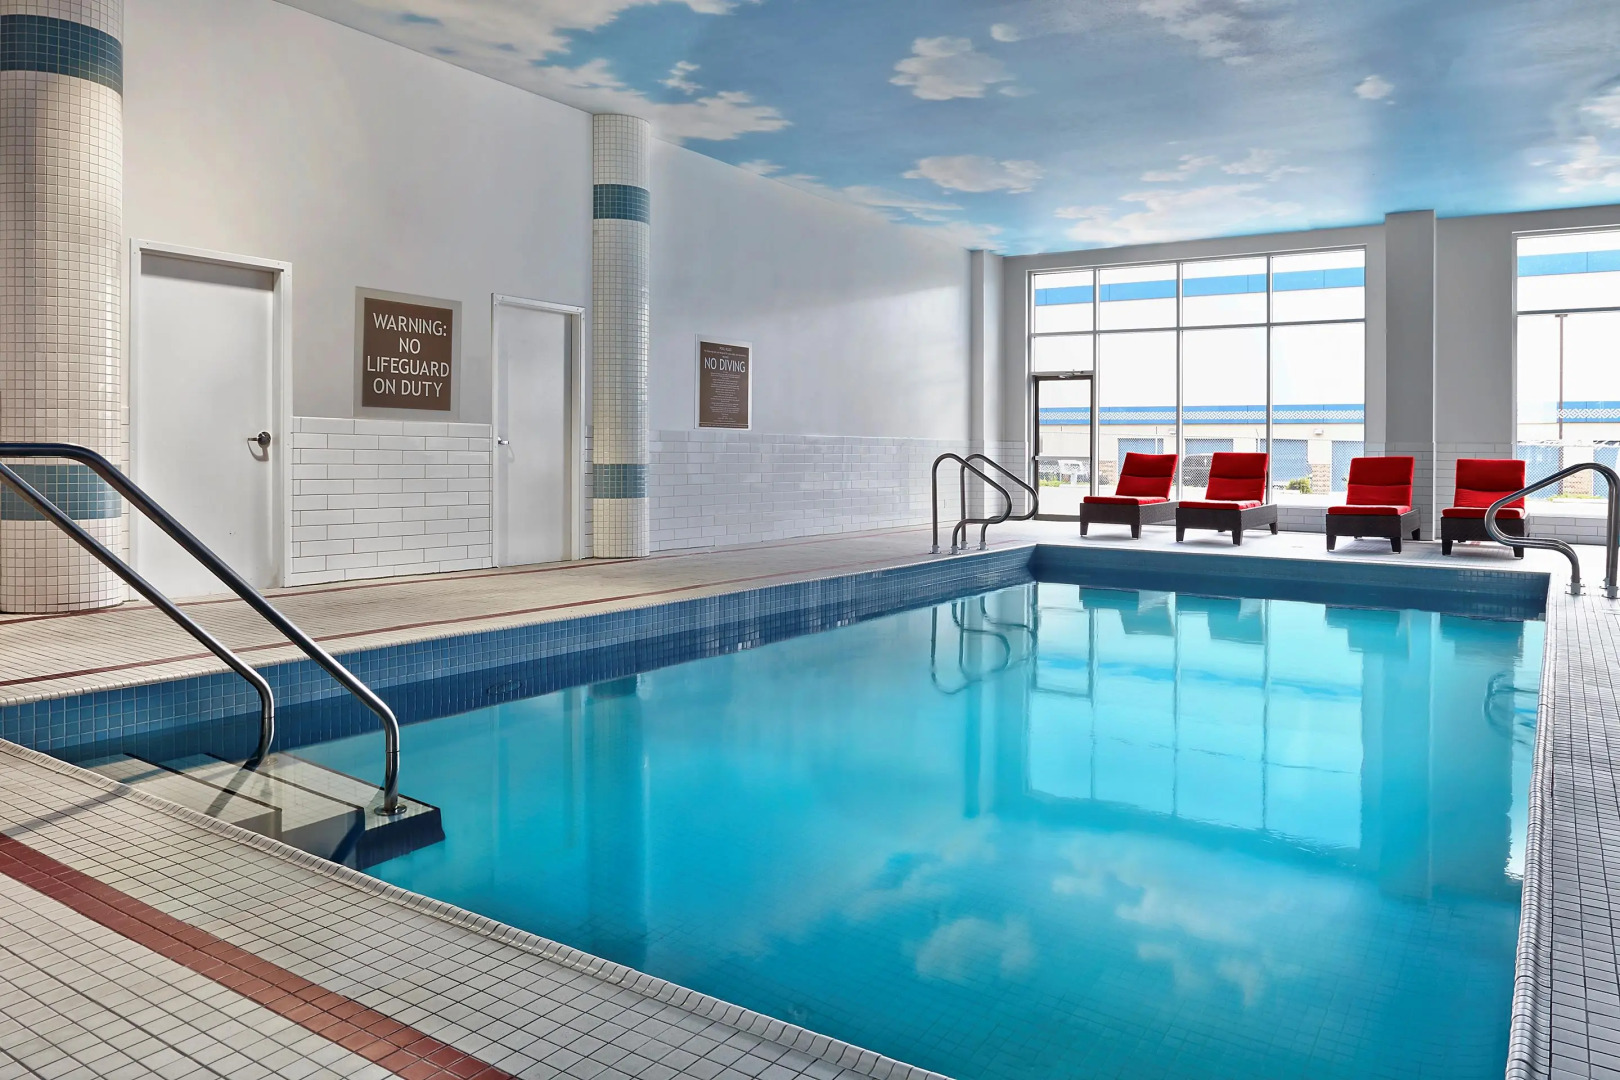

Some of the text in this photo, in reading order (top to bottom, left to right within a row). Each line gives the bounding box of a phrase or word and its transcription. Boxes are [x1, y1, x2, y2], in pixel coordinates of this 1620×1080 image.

[372, 312, 447, 337] WARNING:
[399, 337, 421, 354] NO
[367, 355, 450, 378] LIFEGUARD
[704, 357, 746, 373] NO DIVING
[373, 378, 443, 398] ON DUTY
